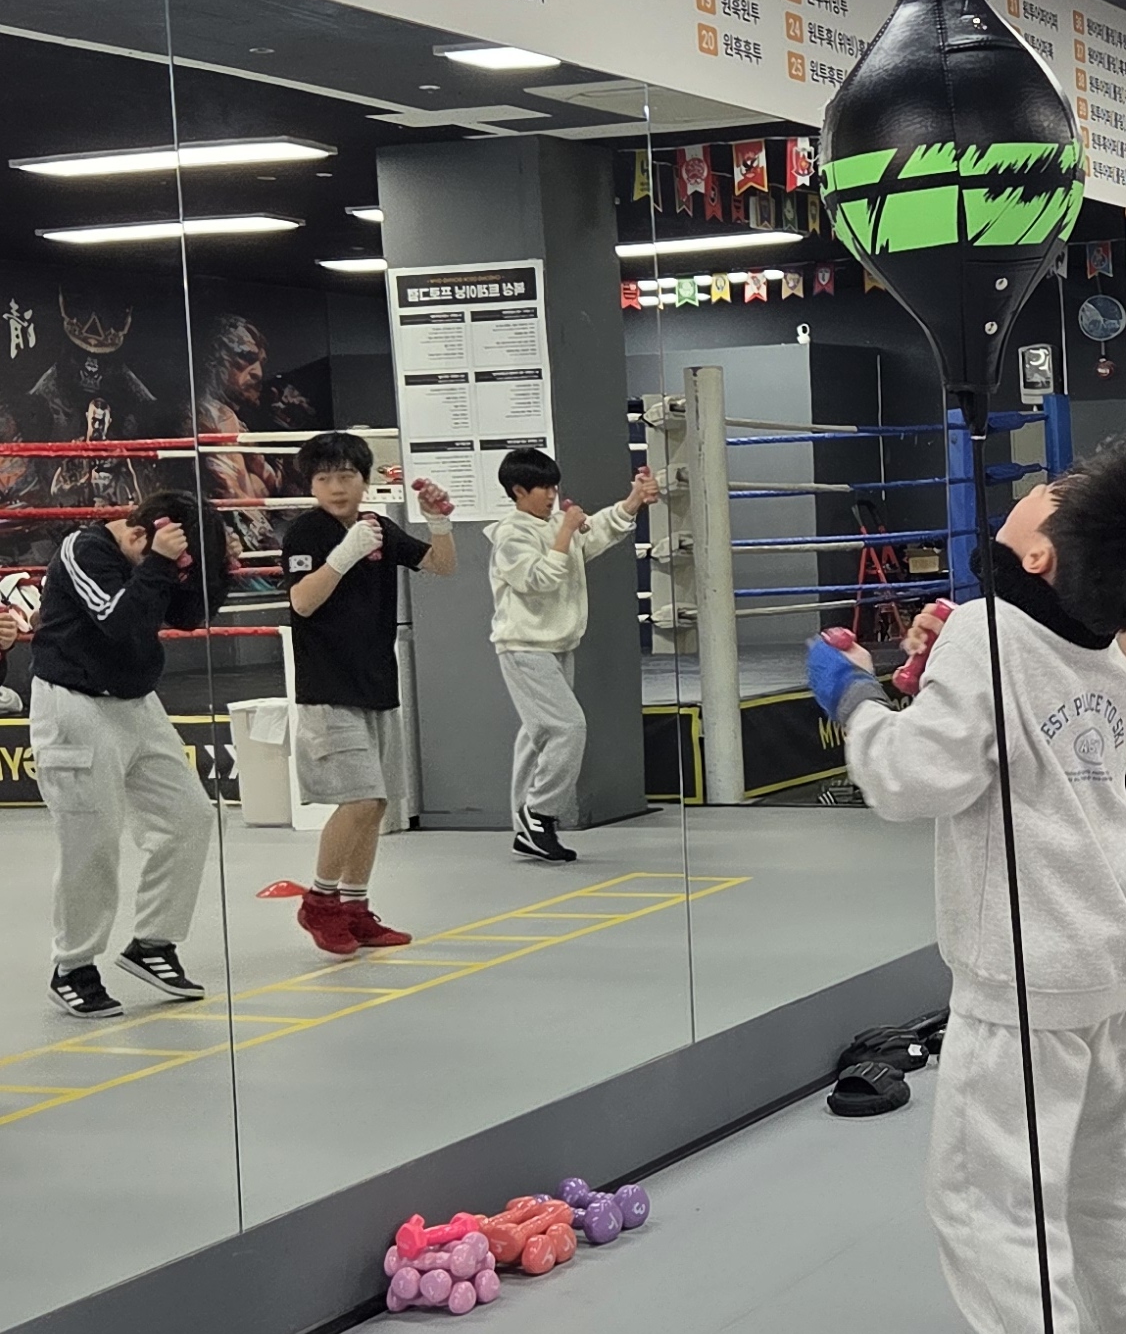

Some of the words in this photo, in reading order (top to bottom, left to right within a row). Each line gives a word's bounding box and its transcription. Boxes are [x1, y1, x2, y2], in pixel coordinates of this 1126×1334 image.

[701, 30, 715, 50] 20
[723, 33, 762, 65] 원훅훅투
[789, 18, 801, 38] 24
[808, 22, 870, 58] 원투훅(위빙)훅
[791, 56, 803, 76] 25
[1040, 704, 1069, 745] EST
[1104, 699, 1117, 724] TO
[1112, 718, 1124, 749] SKI
